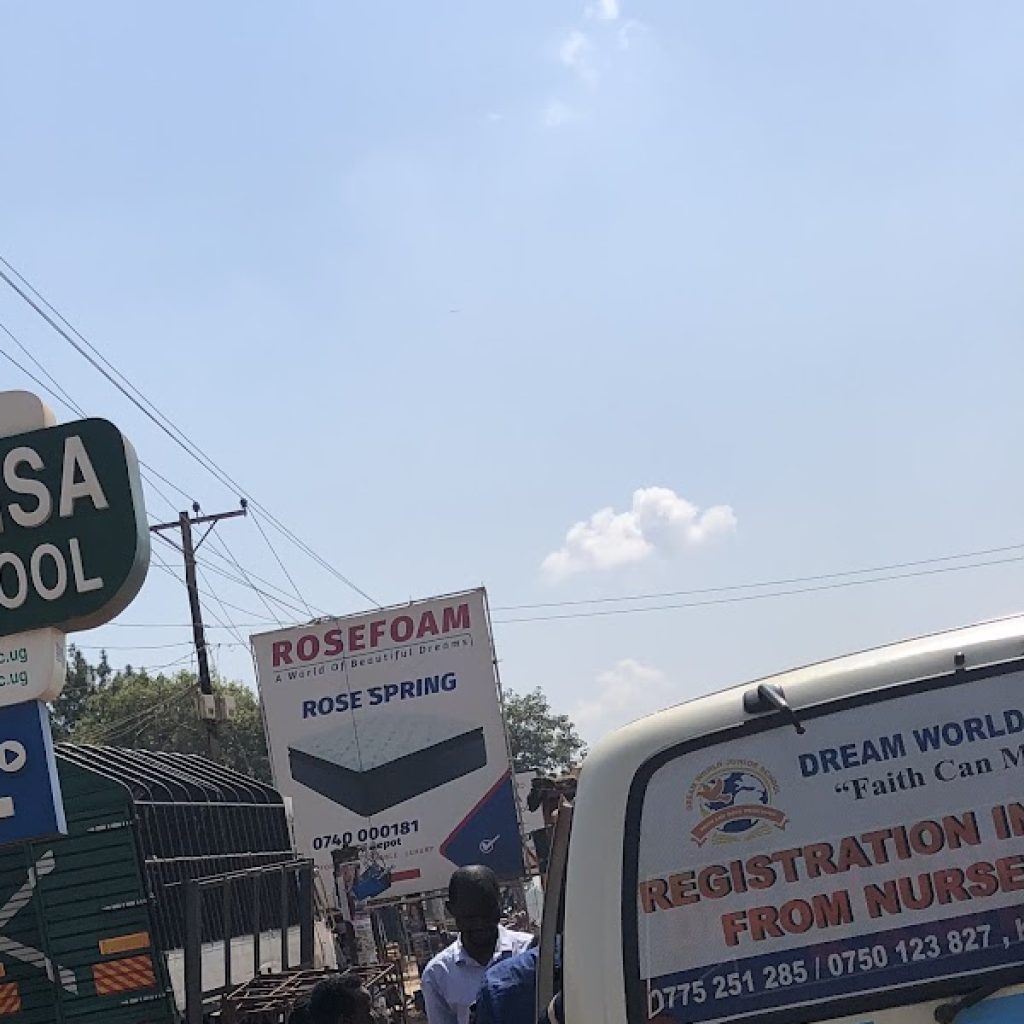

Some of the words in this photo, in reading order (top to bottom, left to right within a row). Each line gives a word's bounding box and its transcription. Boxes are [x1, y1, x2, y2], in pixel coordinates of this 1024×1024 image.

[272, 603, 471, 668] ROSEFOAM
[274, 675, 282, 684] A
[287, 666, 326, 681] World
[351, 649, 413, 669] Beautiful
[302, 690, 363, 719] ROSE
[367, 672, 457, 706] SPRING
[798, 733, 907, 778] DREAM
[912, 709, 1024, 753] WORLD
[934, 757, 993, 782] Can
[313, 832, 353, 850] 0740
[358, 819, 419, 842] 000181
[639, 810, 982, 914] REGISTRATION
[721, 889, 854, 947] FROM
[863, 854, 1024, 919] NURSE
[712, 970, 754, 1000] 251
[763, 960, 808, 990] 285
[828, 945, 888, 977] 0750
[896, 934, 941, 964] 123
[947, 924, 991, 955] 827
